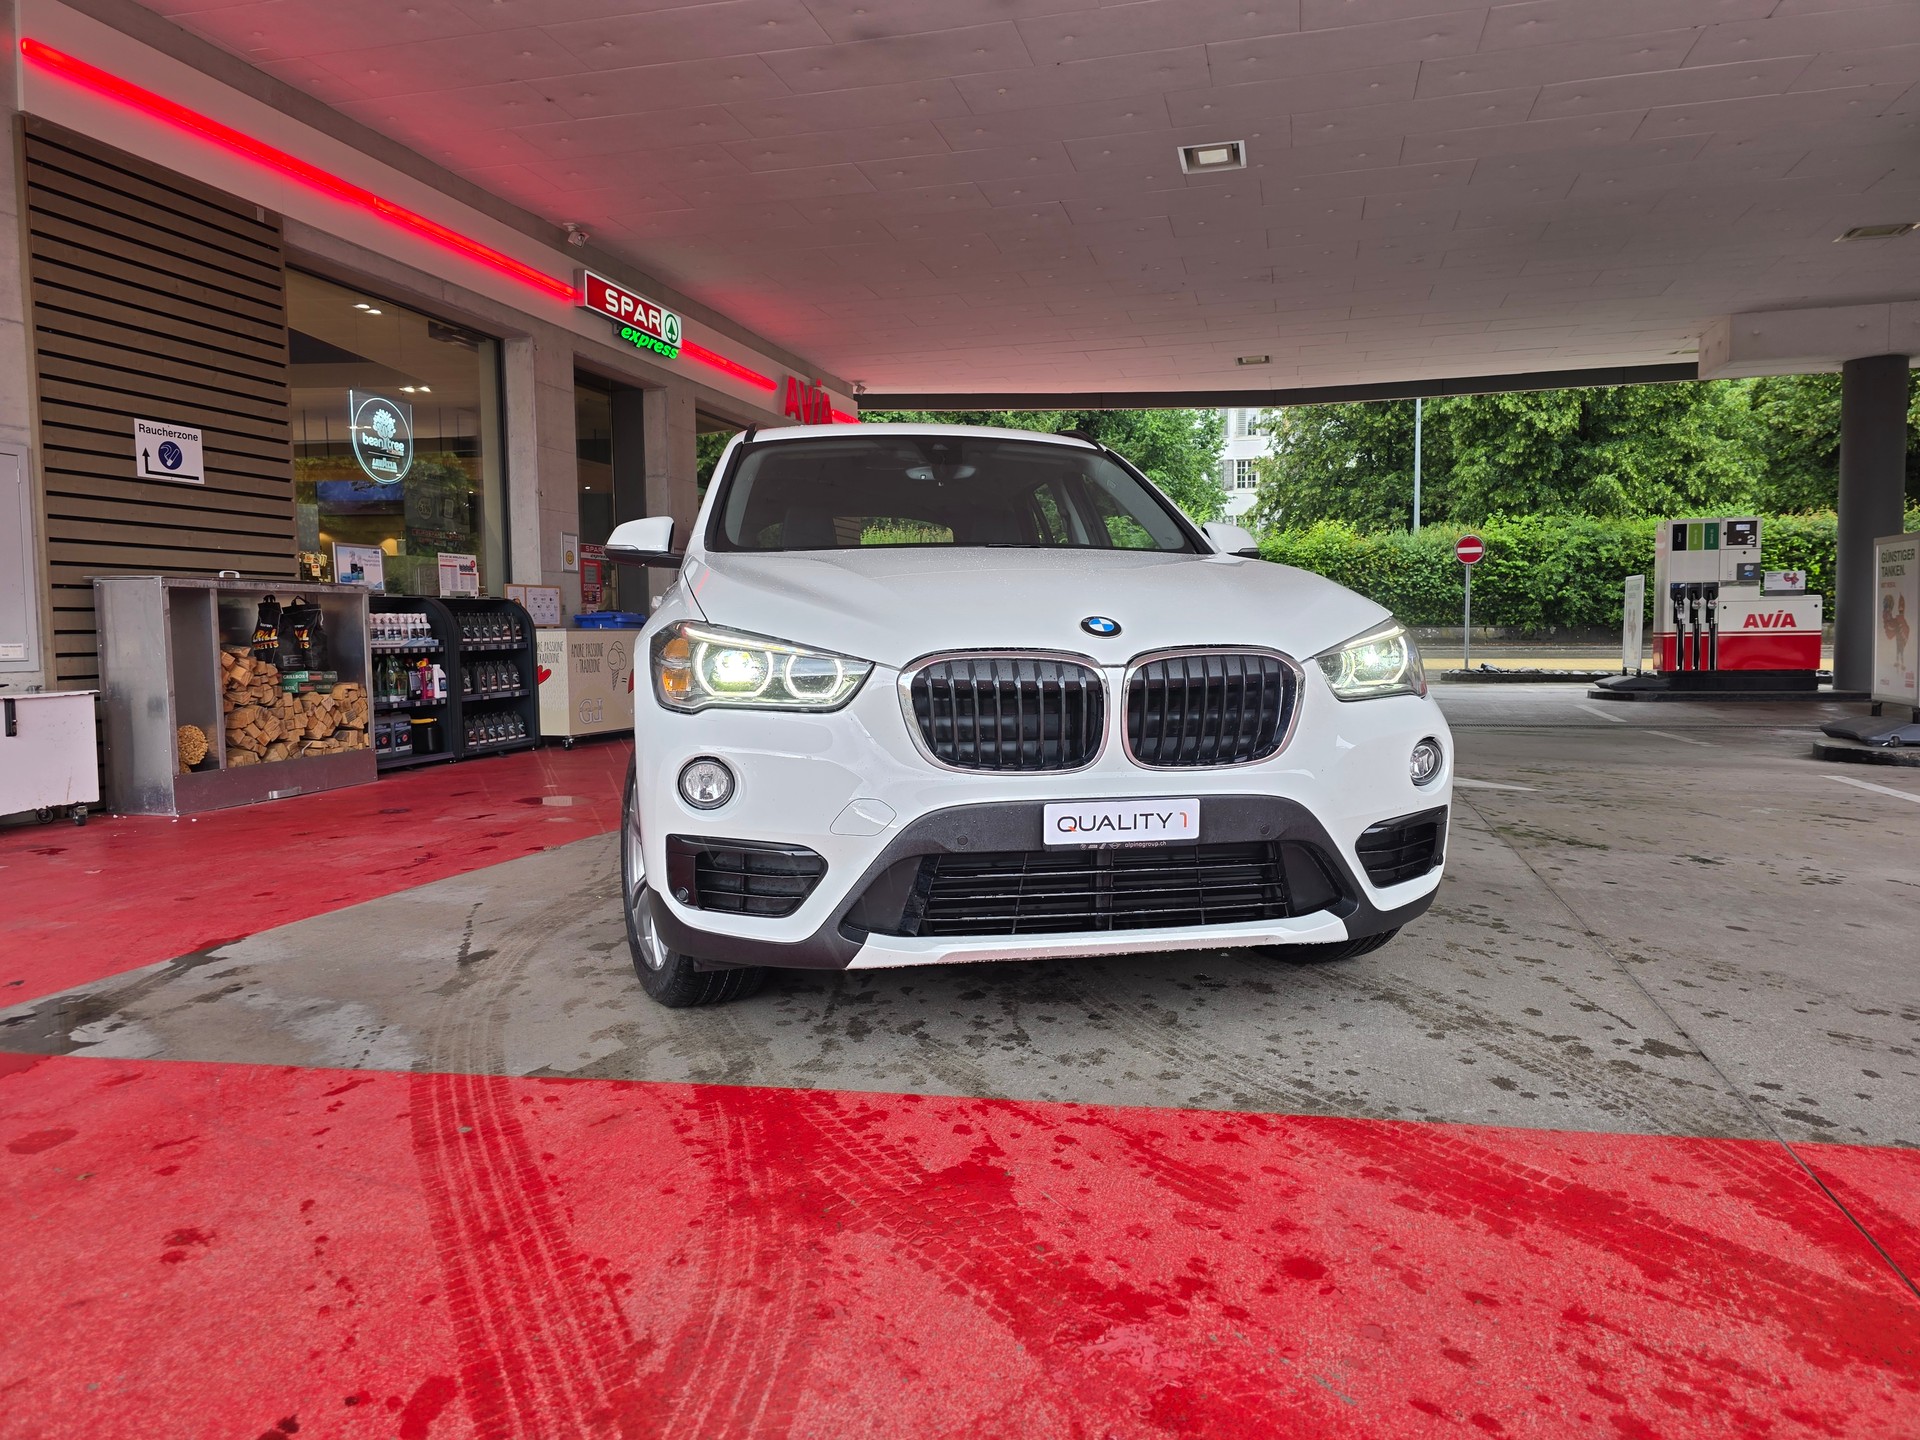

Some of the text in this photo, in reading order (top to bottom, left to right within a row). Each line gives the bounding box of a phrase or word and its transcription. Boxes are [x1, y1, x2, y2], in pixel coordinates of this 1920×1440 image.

[605, 288, 661, 333] SPAR
[620, 326, 679, 359] express
[138, 423, 198, 441] Raucherzone
[1747, 535, 1756, 544] 2
[1881, 548, 1916, 564] GÜNSTIGER
[1057, 811, 1188, 833] QUALITY 1
